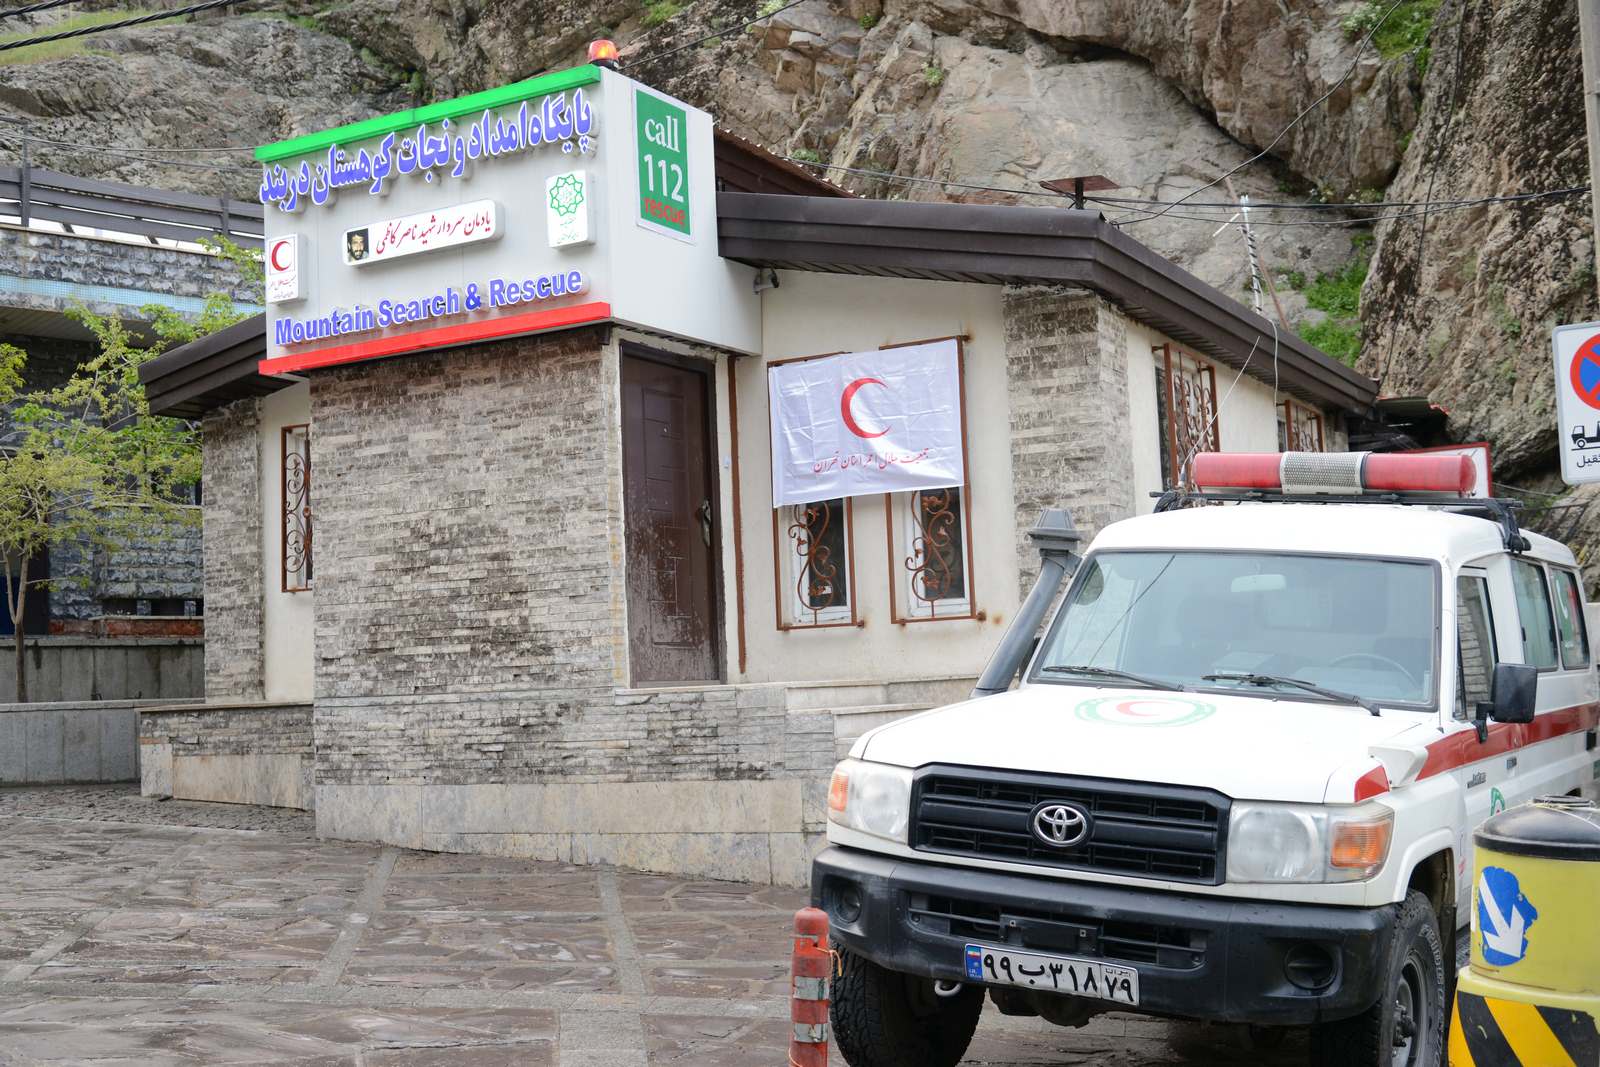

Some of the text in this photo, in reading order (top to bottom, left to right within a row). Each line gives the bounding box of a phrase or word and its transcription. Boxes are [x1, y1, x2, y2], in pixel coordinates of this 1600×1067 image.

[259, 88, 592, 212] پایگاه امداد و نجات کوهستان دربند
[644, 115, 680, 153] call
[643, 153, 685, 204] 112
[375, 211, 491, 254] یادمان سردار شهید ناصر کاظمی
[643, 197, 686, 226] rescue
[274, 269, 583, 345] Mountain Search & Rescue
[813, 449, 840, 473] تهران
